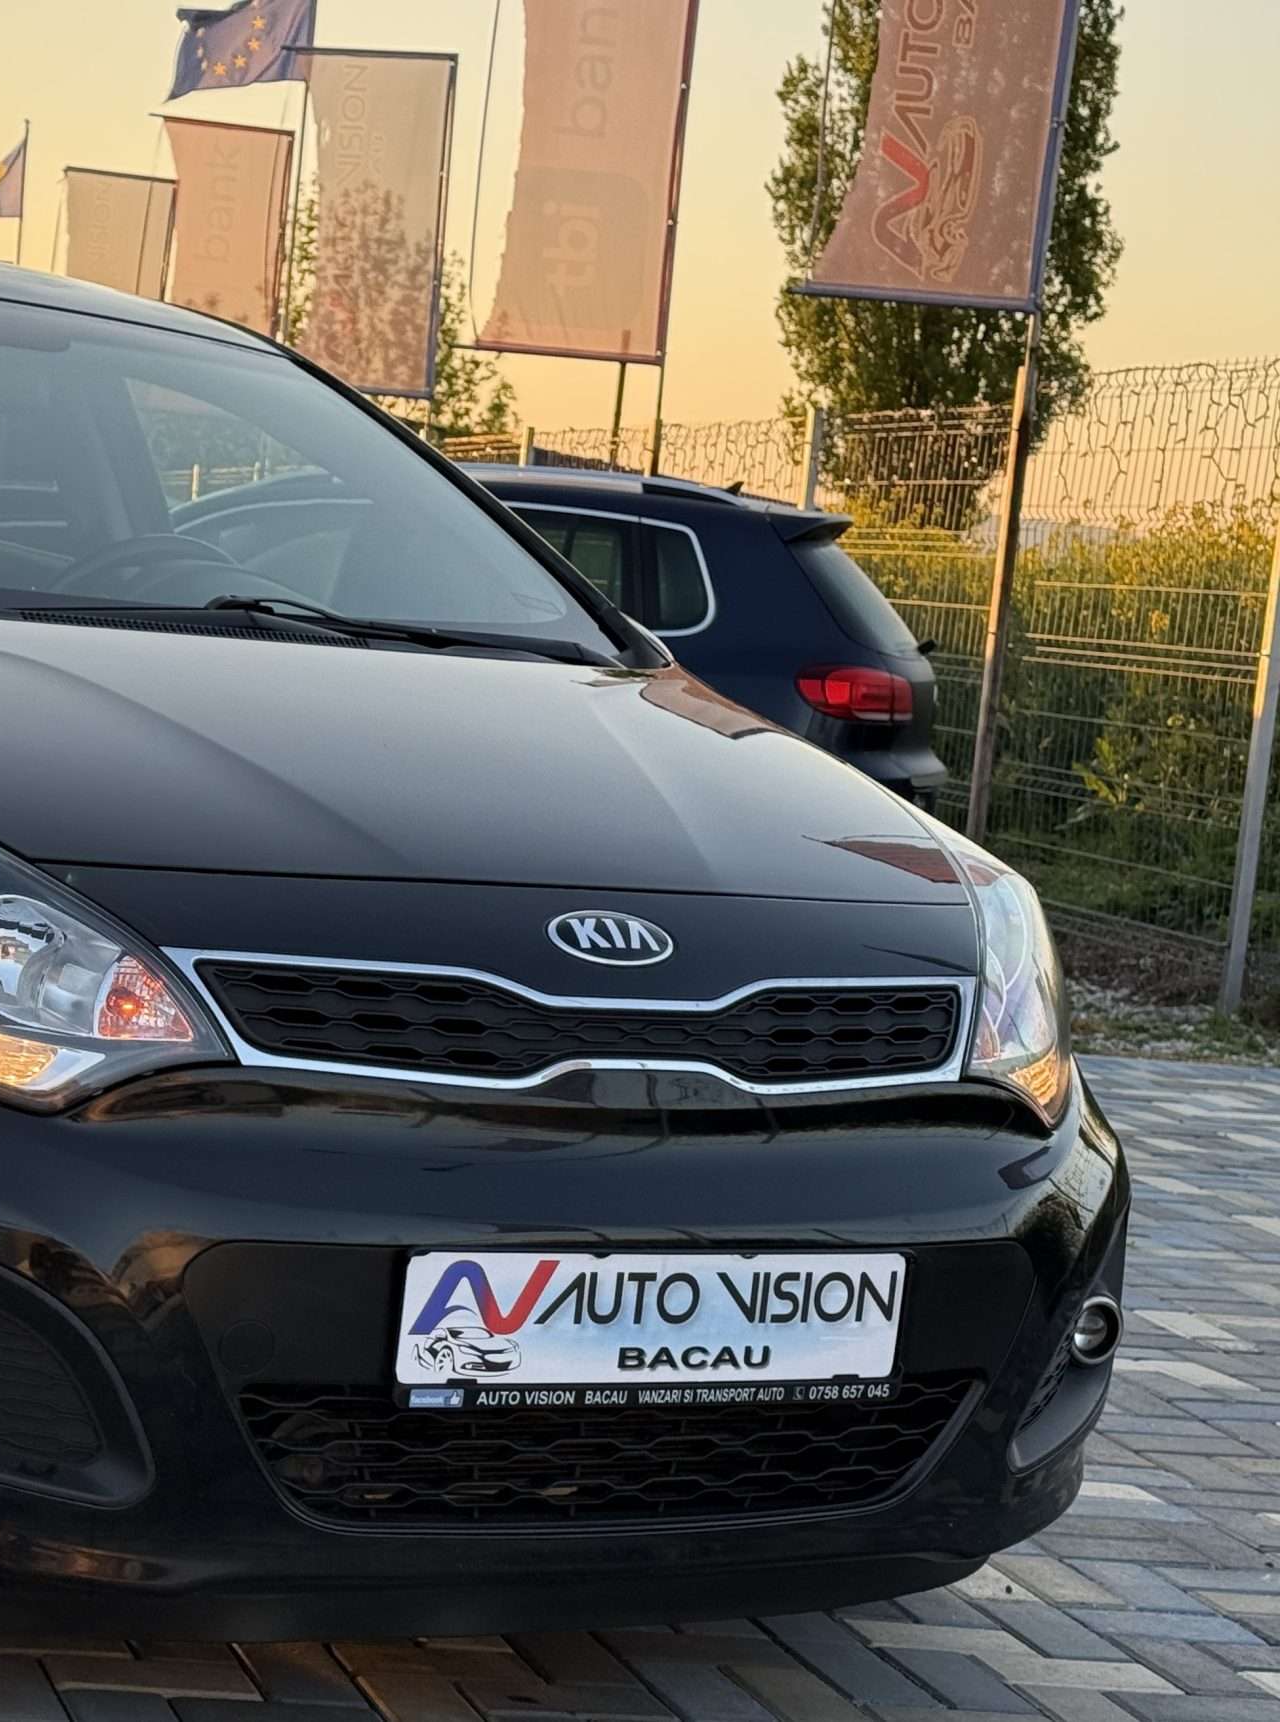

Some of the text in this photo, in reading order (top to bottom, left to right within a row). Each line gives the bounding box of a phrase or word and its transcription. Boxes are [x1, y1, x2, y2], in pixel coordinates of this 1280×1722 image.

[336, 64, 369, 186] VISION
[191, 142, 242, 264] bank
[541, 199, 601, 295] tbi
[566, 918, 661, 951] KIA
[534, 1271, 701, 1325] AUTO
[716, 1270, 898, 1324] VISION
[616, 1345, 771, 1371] BACAU
[476, 1391, 520, 1405] AUTO
[525, 1391, 576, 1405] VISION
[585, 1390, 628, 1404] BACAU
[638, 1389, 682, 1404] VANZARI
[695, 1387, 756, 1403] TRANSPORT
[757, 1386, 785, 1401] AUTO
[808, 1385, 839, 1400] 0758
[842, 1385, 864, 1399] 657
[868, 1384, 890, 1398] 045
